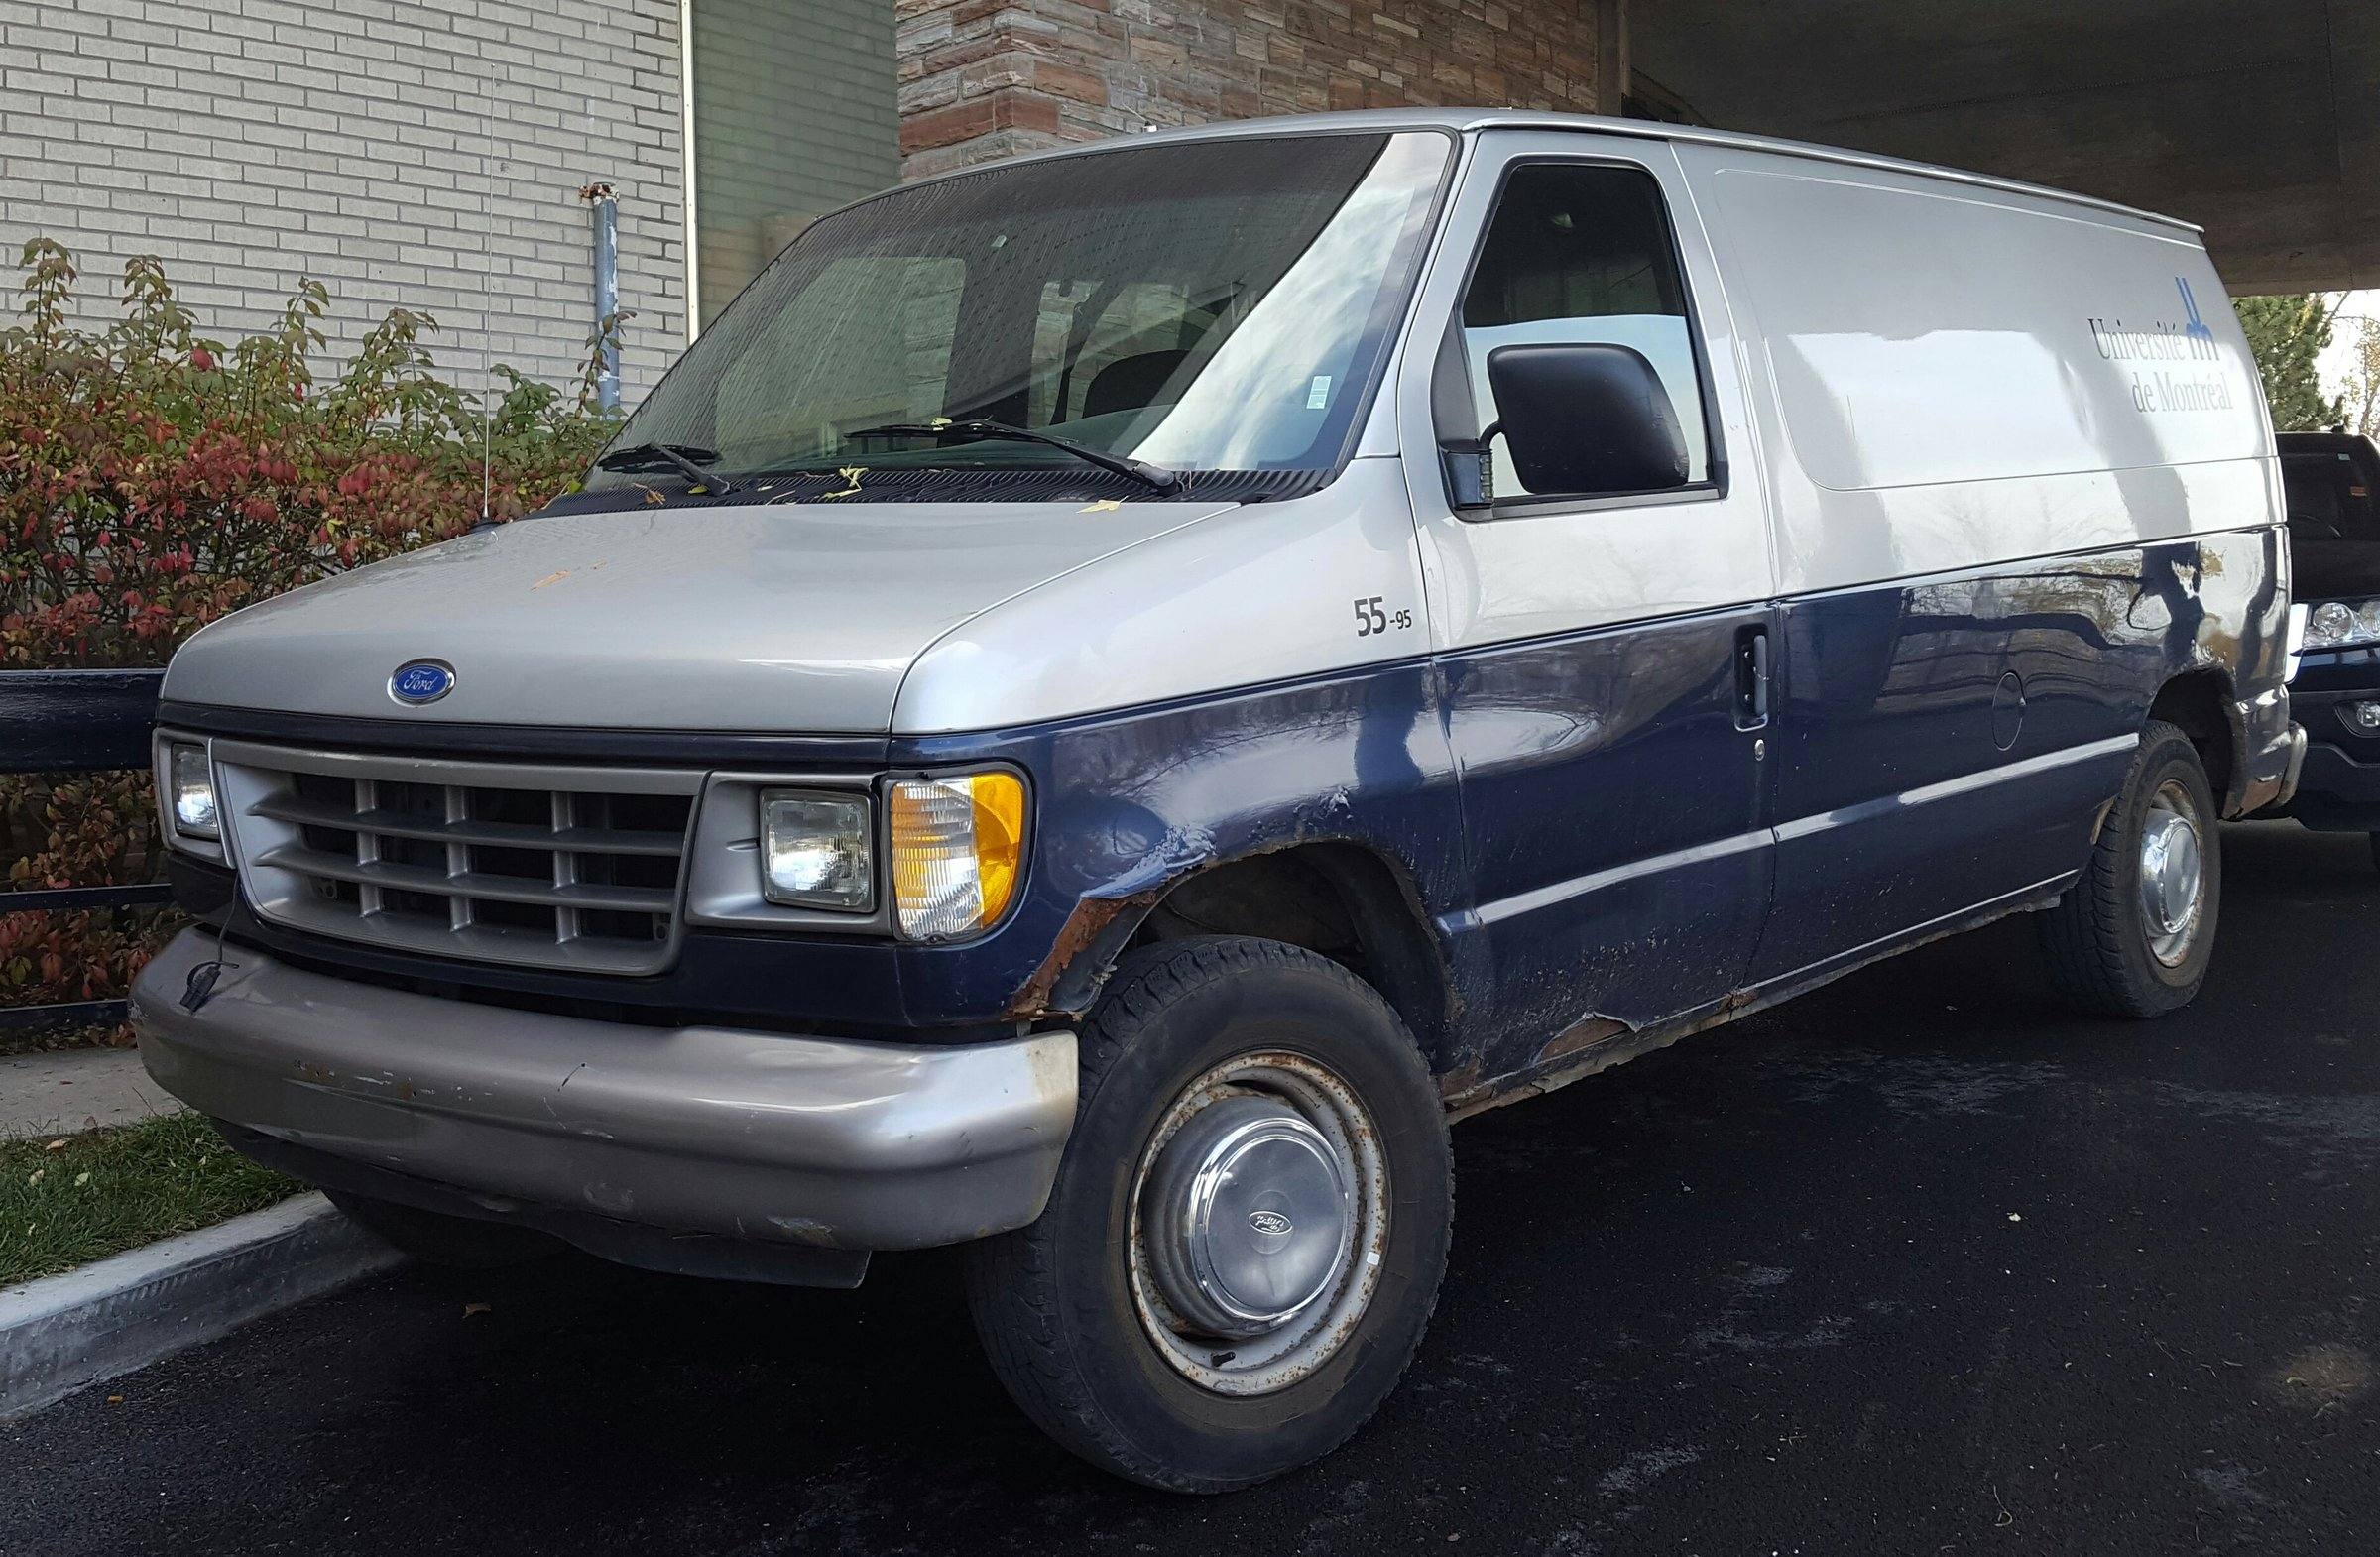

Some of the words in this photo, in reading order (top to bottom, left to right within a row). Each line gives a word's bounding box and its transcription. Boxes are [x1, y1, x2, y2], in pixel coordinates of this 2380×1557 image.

[2087, 318, 2188, 361] Université
[2132, 372, 2156, 414] de
[2154, 371, 2234, 414] Montréal
[403, 669, 438, 691] Ford
